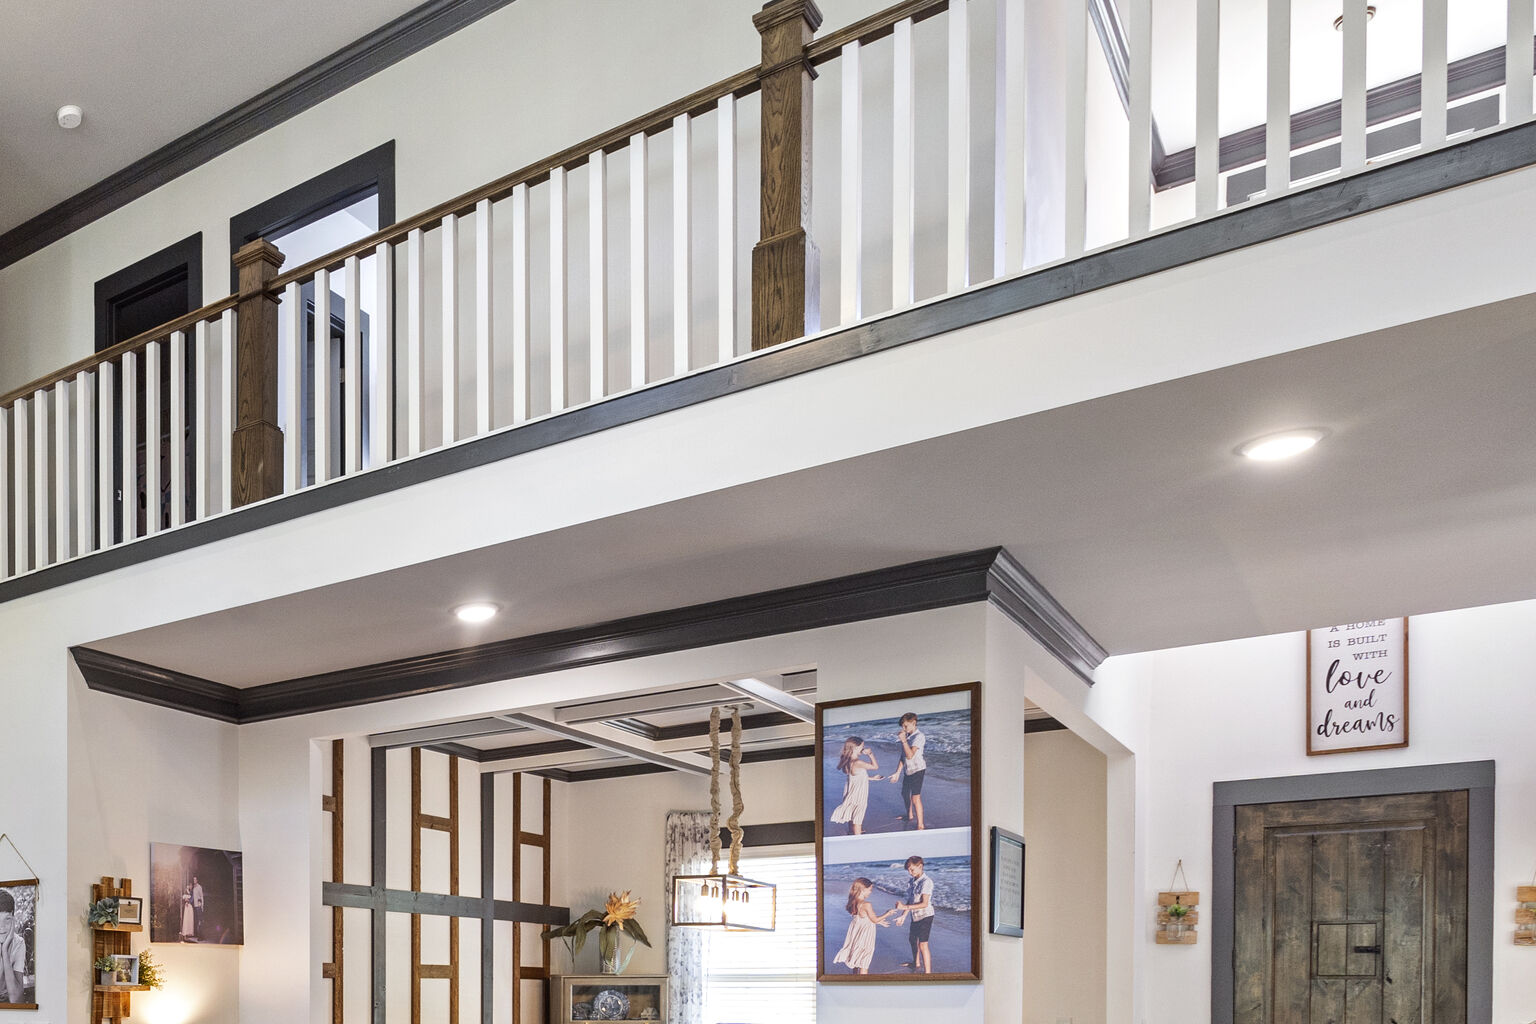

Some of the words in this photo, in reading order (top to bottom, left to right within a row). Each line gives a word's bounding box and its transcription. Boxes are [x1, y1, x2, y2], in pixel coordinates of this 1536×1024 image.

[1328, 640, 1340, 648] IS
[1347, 634, 1387, 646] BUILT
[1352, 650, 1388, 661] WITH
[1325, 659, 1393, 694] love
[1344, 688, 1378, 711] and
[1316, 709, 1400, 738] dreams
